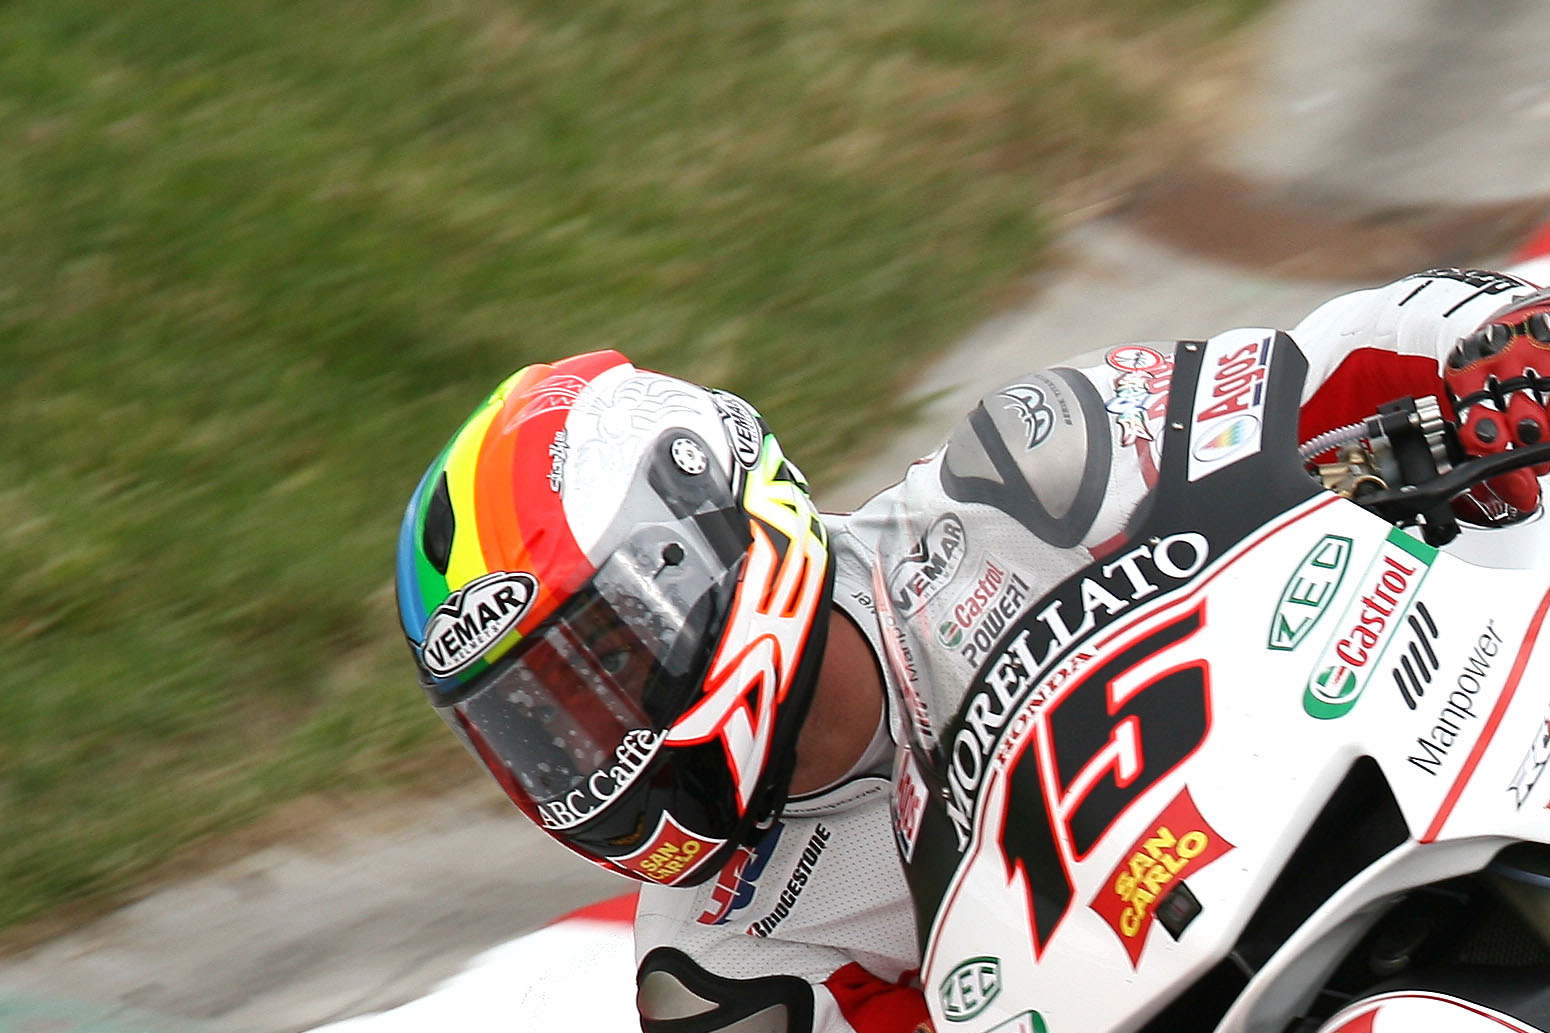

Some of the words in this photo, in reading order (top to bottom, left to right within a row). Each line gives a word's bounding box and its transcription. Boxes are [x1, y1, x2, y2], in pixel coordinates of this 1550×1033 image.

[1196, 341, 1264, 422] Agos
[894, 523, 965, 612] VEMAR
[953, 559, 1005, 629] Castrol
[428, 586, 524, 667] VEMAR
[1336, 555, 1417, 667] Castrol
[946, 531, 1210, 853] MORELLATO
[1407, 619, 1503, 776] Manpower
[537, 788, 594, 828] ABC
[998, 596, 1214, 964] 15
[639, 841, 681, 873] SAN
[647, 839, 701, 881] CARLO
[746, 822, 831, 938] BRIDGESTONE
[1114, 825, 1178, 902] SAN
[1119, 829, 1210, 938] CARLO
